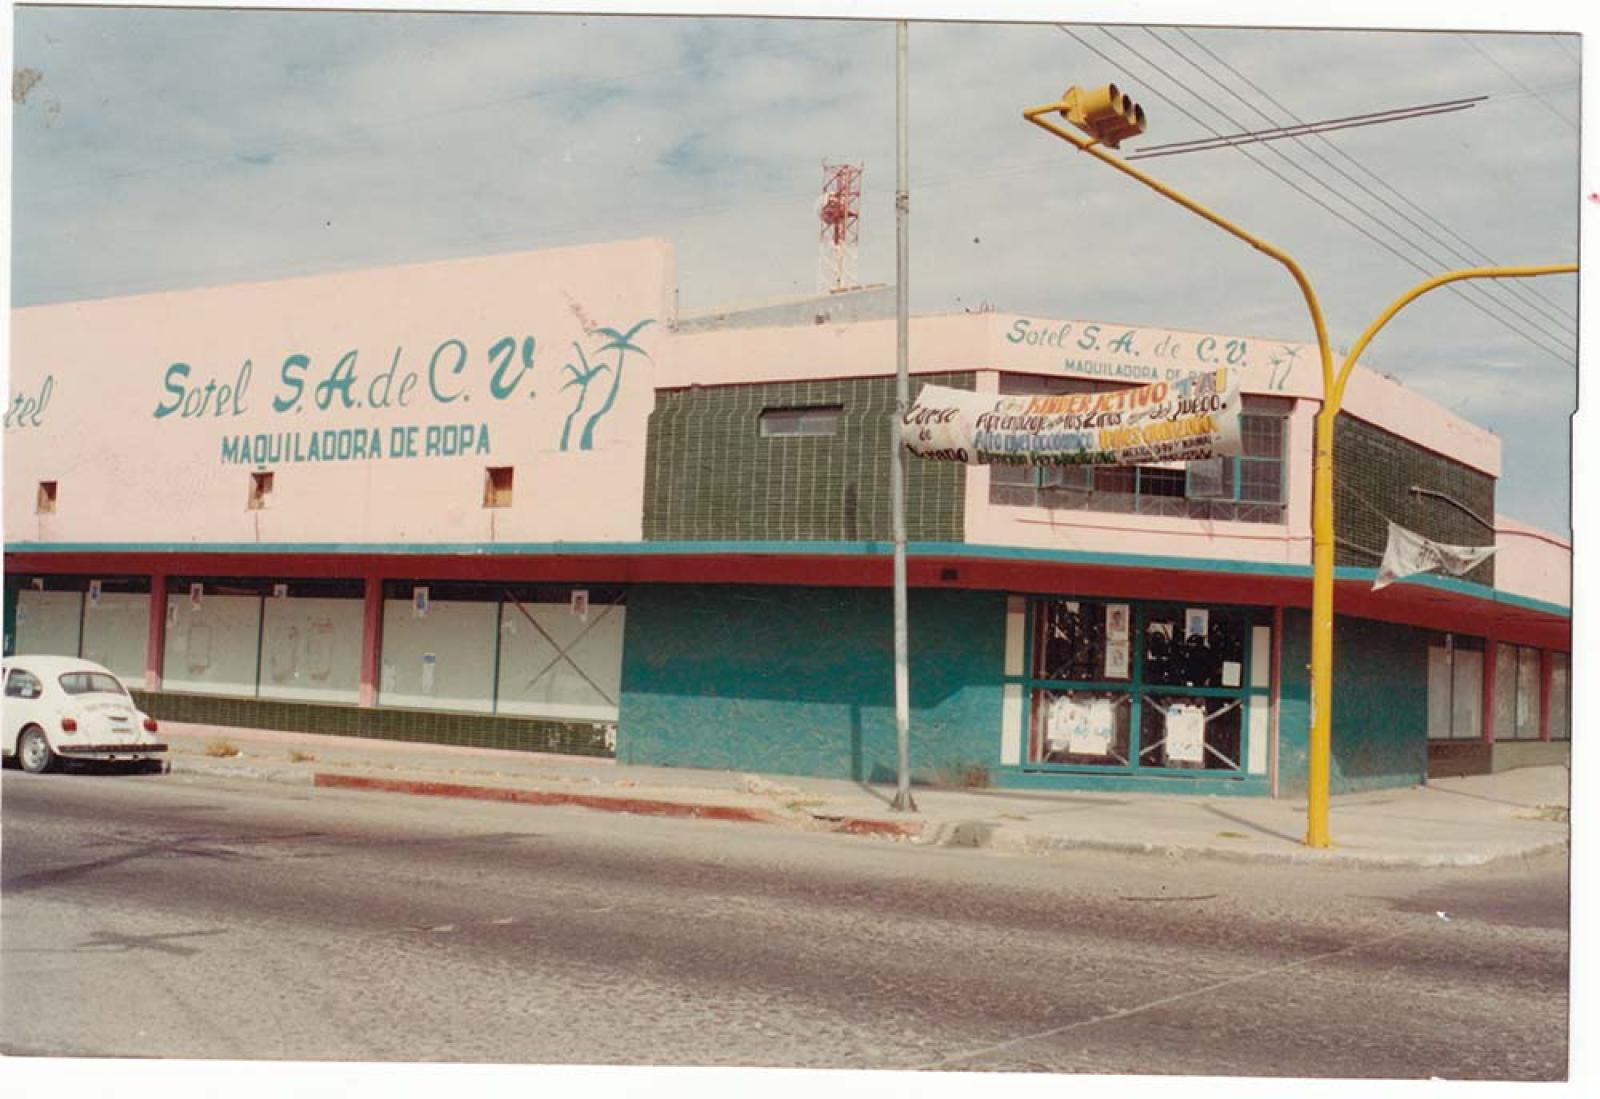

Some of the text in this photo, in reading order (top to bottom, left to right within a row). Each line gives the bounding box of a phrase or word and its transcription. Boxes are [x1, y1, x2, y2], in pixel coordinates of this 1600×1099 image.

[1006, 319, 1072, 349] Sotel
[1154, 335, 1181, 358] de
[153, 358, 252, 419] Sotel
[367, 345, 418, 408] de
[1064, 359, 1158, 379] MAQUILADORA
[4, 375, 53, 428] tel
[221, 423, 491, 468] MAQUILADORA DE ROPA
